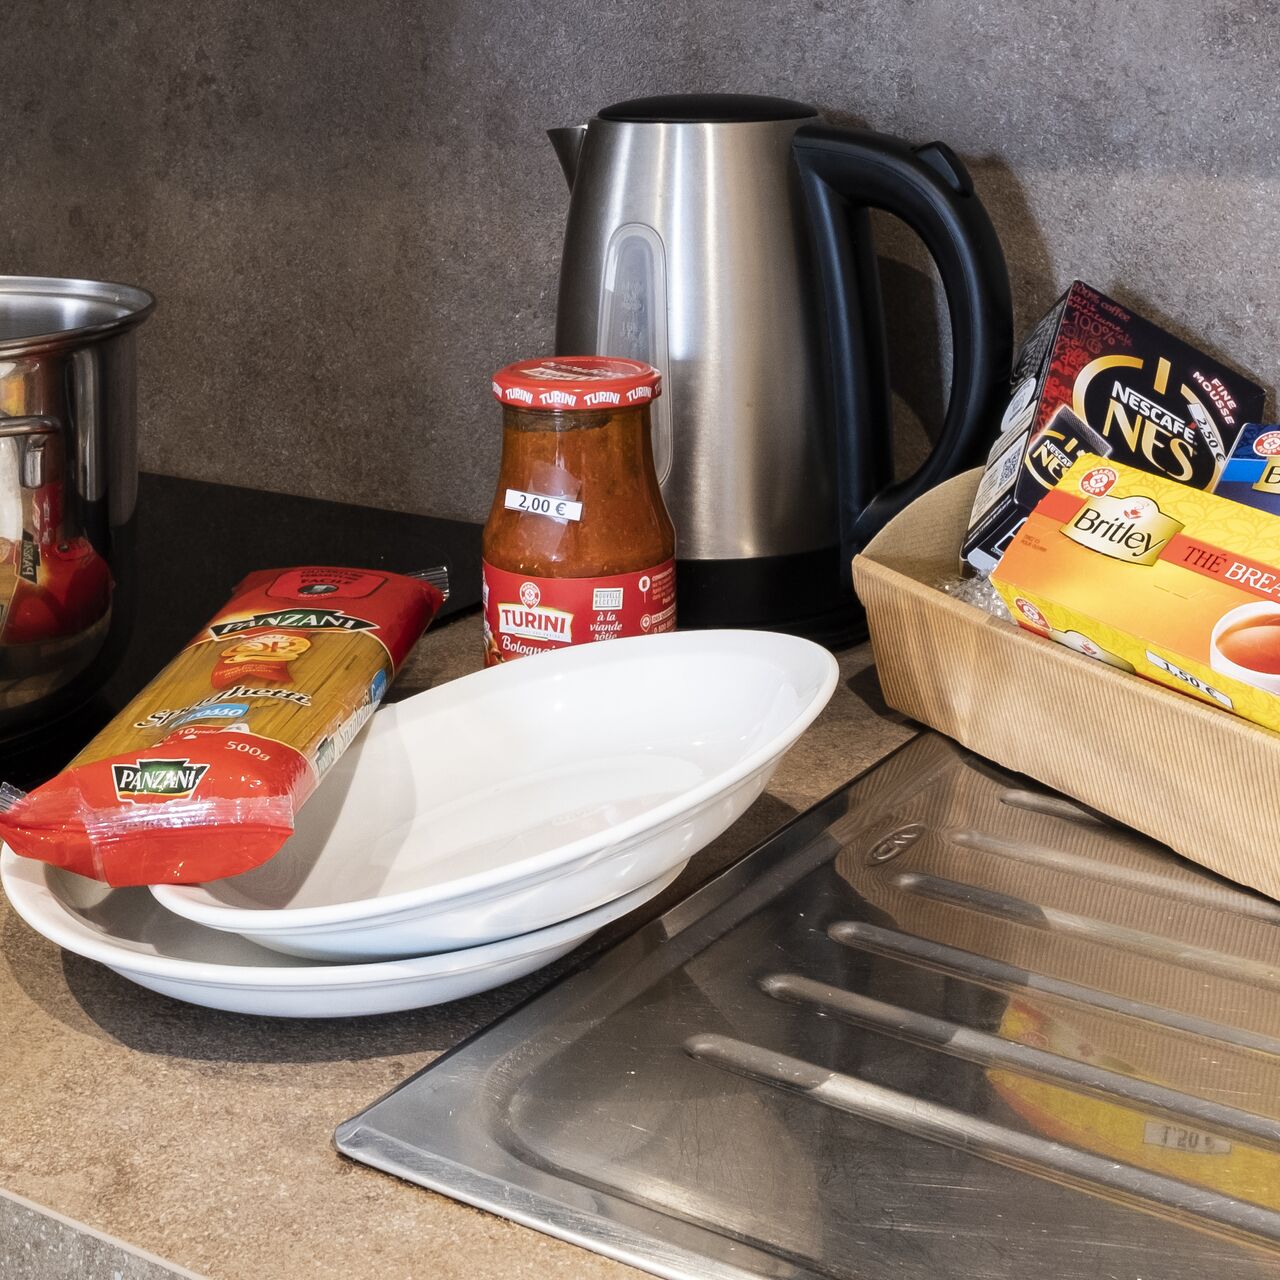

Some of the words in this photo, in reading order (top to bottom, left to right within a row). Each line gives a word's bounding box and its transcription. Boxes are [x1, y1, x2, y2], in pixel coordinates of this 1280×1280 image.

[1073, 311, 1116, 346] 100%
[505, 387, 533, 404] TURINI
[539, 391, 577, 407] TURINI
[584, 392, 621, 406] TURINI
[626, 386, 652, 402] TURINI
[1193, 371, 1235, 425] MOUSSE
[1211, 378, 1237, 410] FINE
[1102, 398, 1194, 482] NES
[1197, 417, 1218, 448] 2,50
[1215, 452, 1226, 462] €
[1043, 439, 1073, 467] NESCAF
[518, 494, 551, 513] 2,00
[556, 502, 567, 516] €
[1074, 507, 1166, 557] Britley
[1183, 545, 1228, 574] THÉ
[220, 614, 358, 634] PANZANI
[502, 609, 566, 634] TURINI
[589, 621, 623, 632] viande
[597, 611, 605, 621] à
[606, 611, 616, 621] la
[502, 635, 556, 656] Bologn
[1163, 661, 1200, 688] 1,50
[1204, 685, 1219, 700] €
[224, 741, 271, 762] 500g
[120, 766, 197, 790] PANZANI
